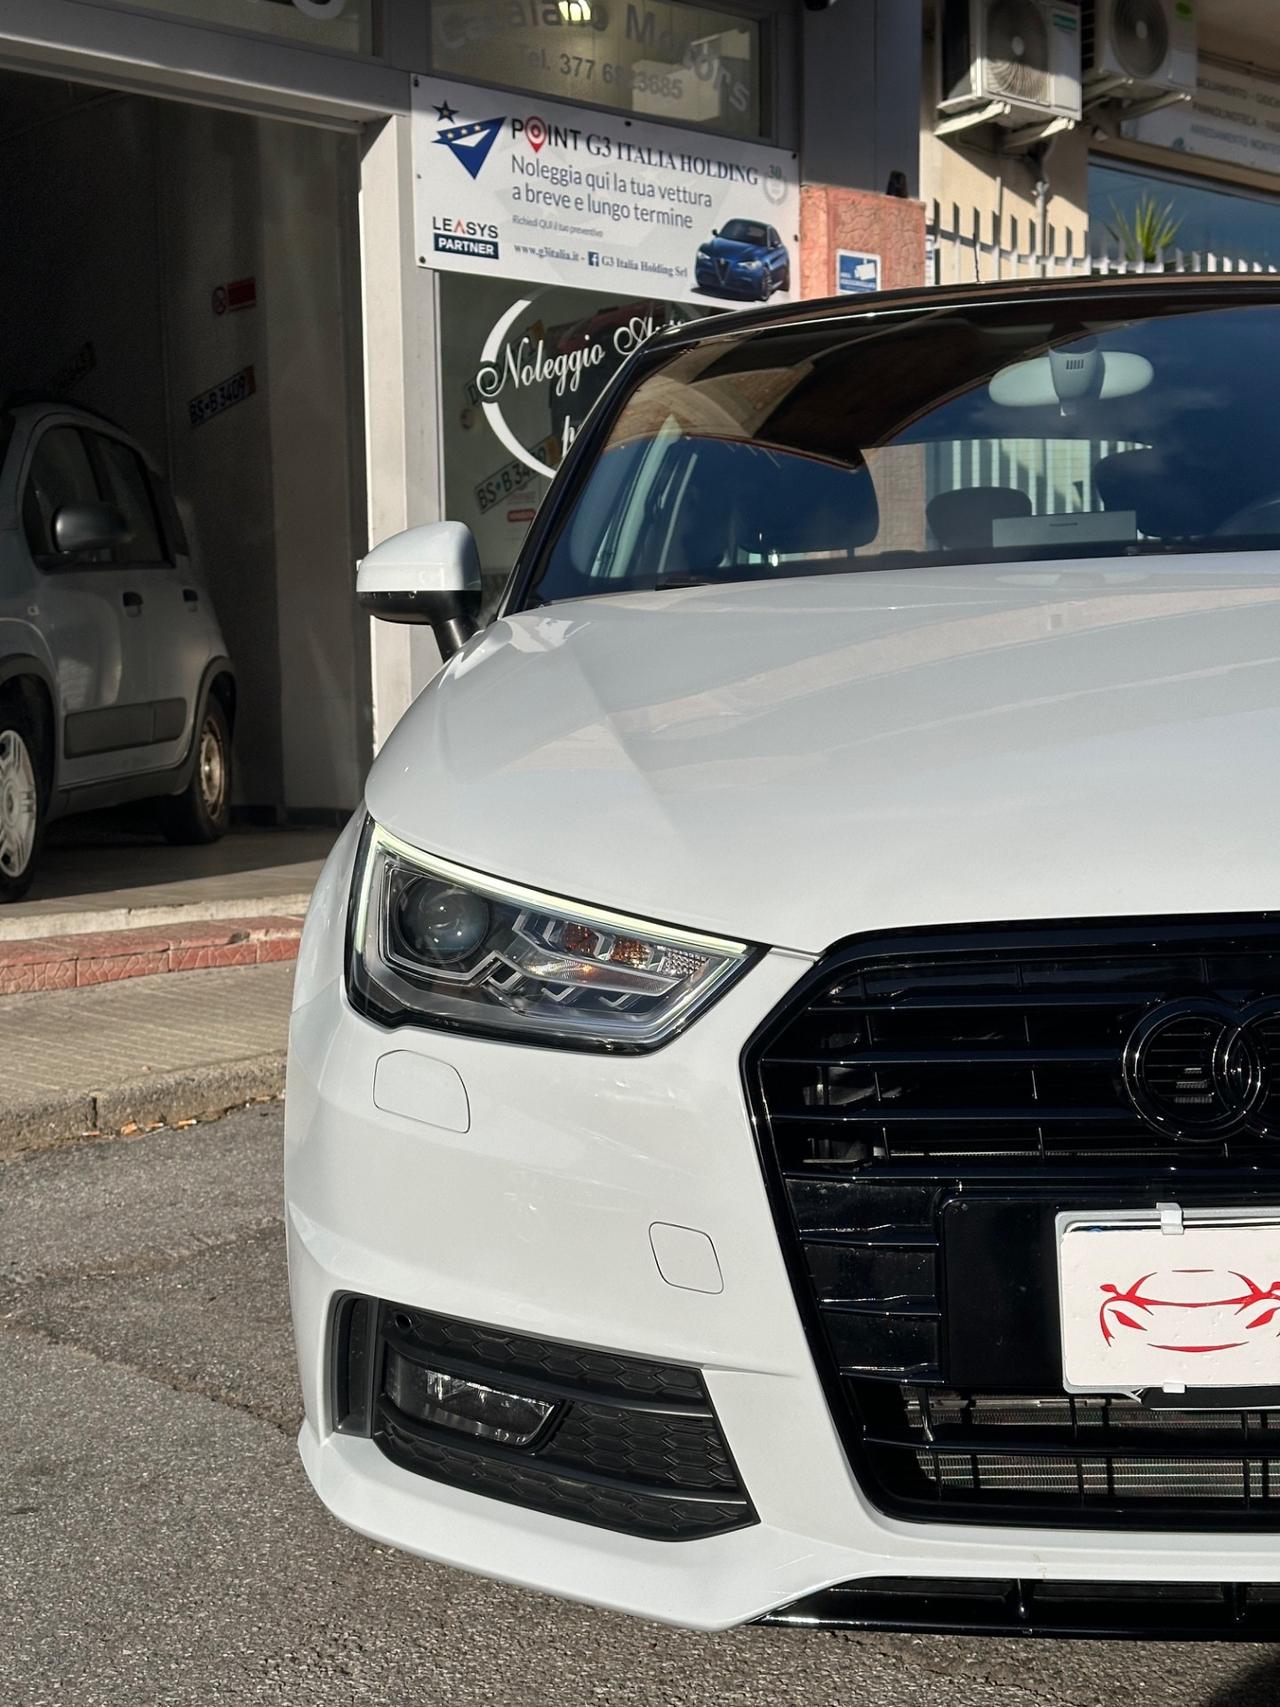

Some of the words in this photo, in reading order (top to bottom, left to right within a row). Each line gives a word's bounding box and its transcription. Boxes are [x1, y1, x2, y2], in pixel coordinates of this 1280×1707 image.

[558, 52, 597, 81] 377
[511, 116, 581, 153] POINT
[586, 133, 611, 158] G3
[617, 141, 677, 171] ITALIA
[680, 153, 758, 186] HOLDING
[511, 154, 582, 187] Noleggia
[585, 171, 610, 192] qui
[613, 172, 627, 193] la
[630, 178, 655, 198] tua
[658, 185, 713, 208] vettura
[512, 185, 521, 201] a
[525, 182, 571, 210] breve
[574, 196, 584, 212] e
[587, 193, 631, 222] lungo
[633, 203, 693, 229] termine
[432, 216, 499, 240] LEASYS
[438, 237, 496, 256] PARTNER
[514, 244, 580, 262] www.g3italia.it
[601, 255, 615, 267] G3
[616, 257, 639, 271] Italia
[640, 260, 673, 277] Holding
[674, 264, 688, 278] Srl
[476, 334, 605, 397] Noleggio
